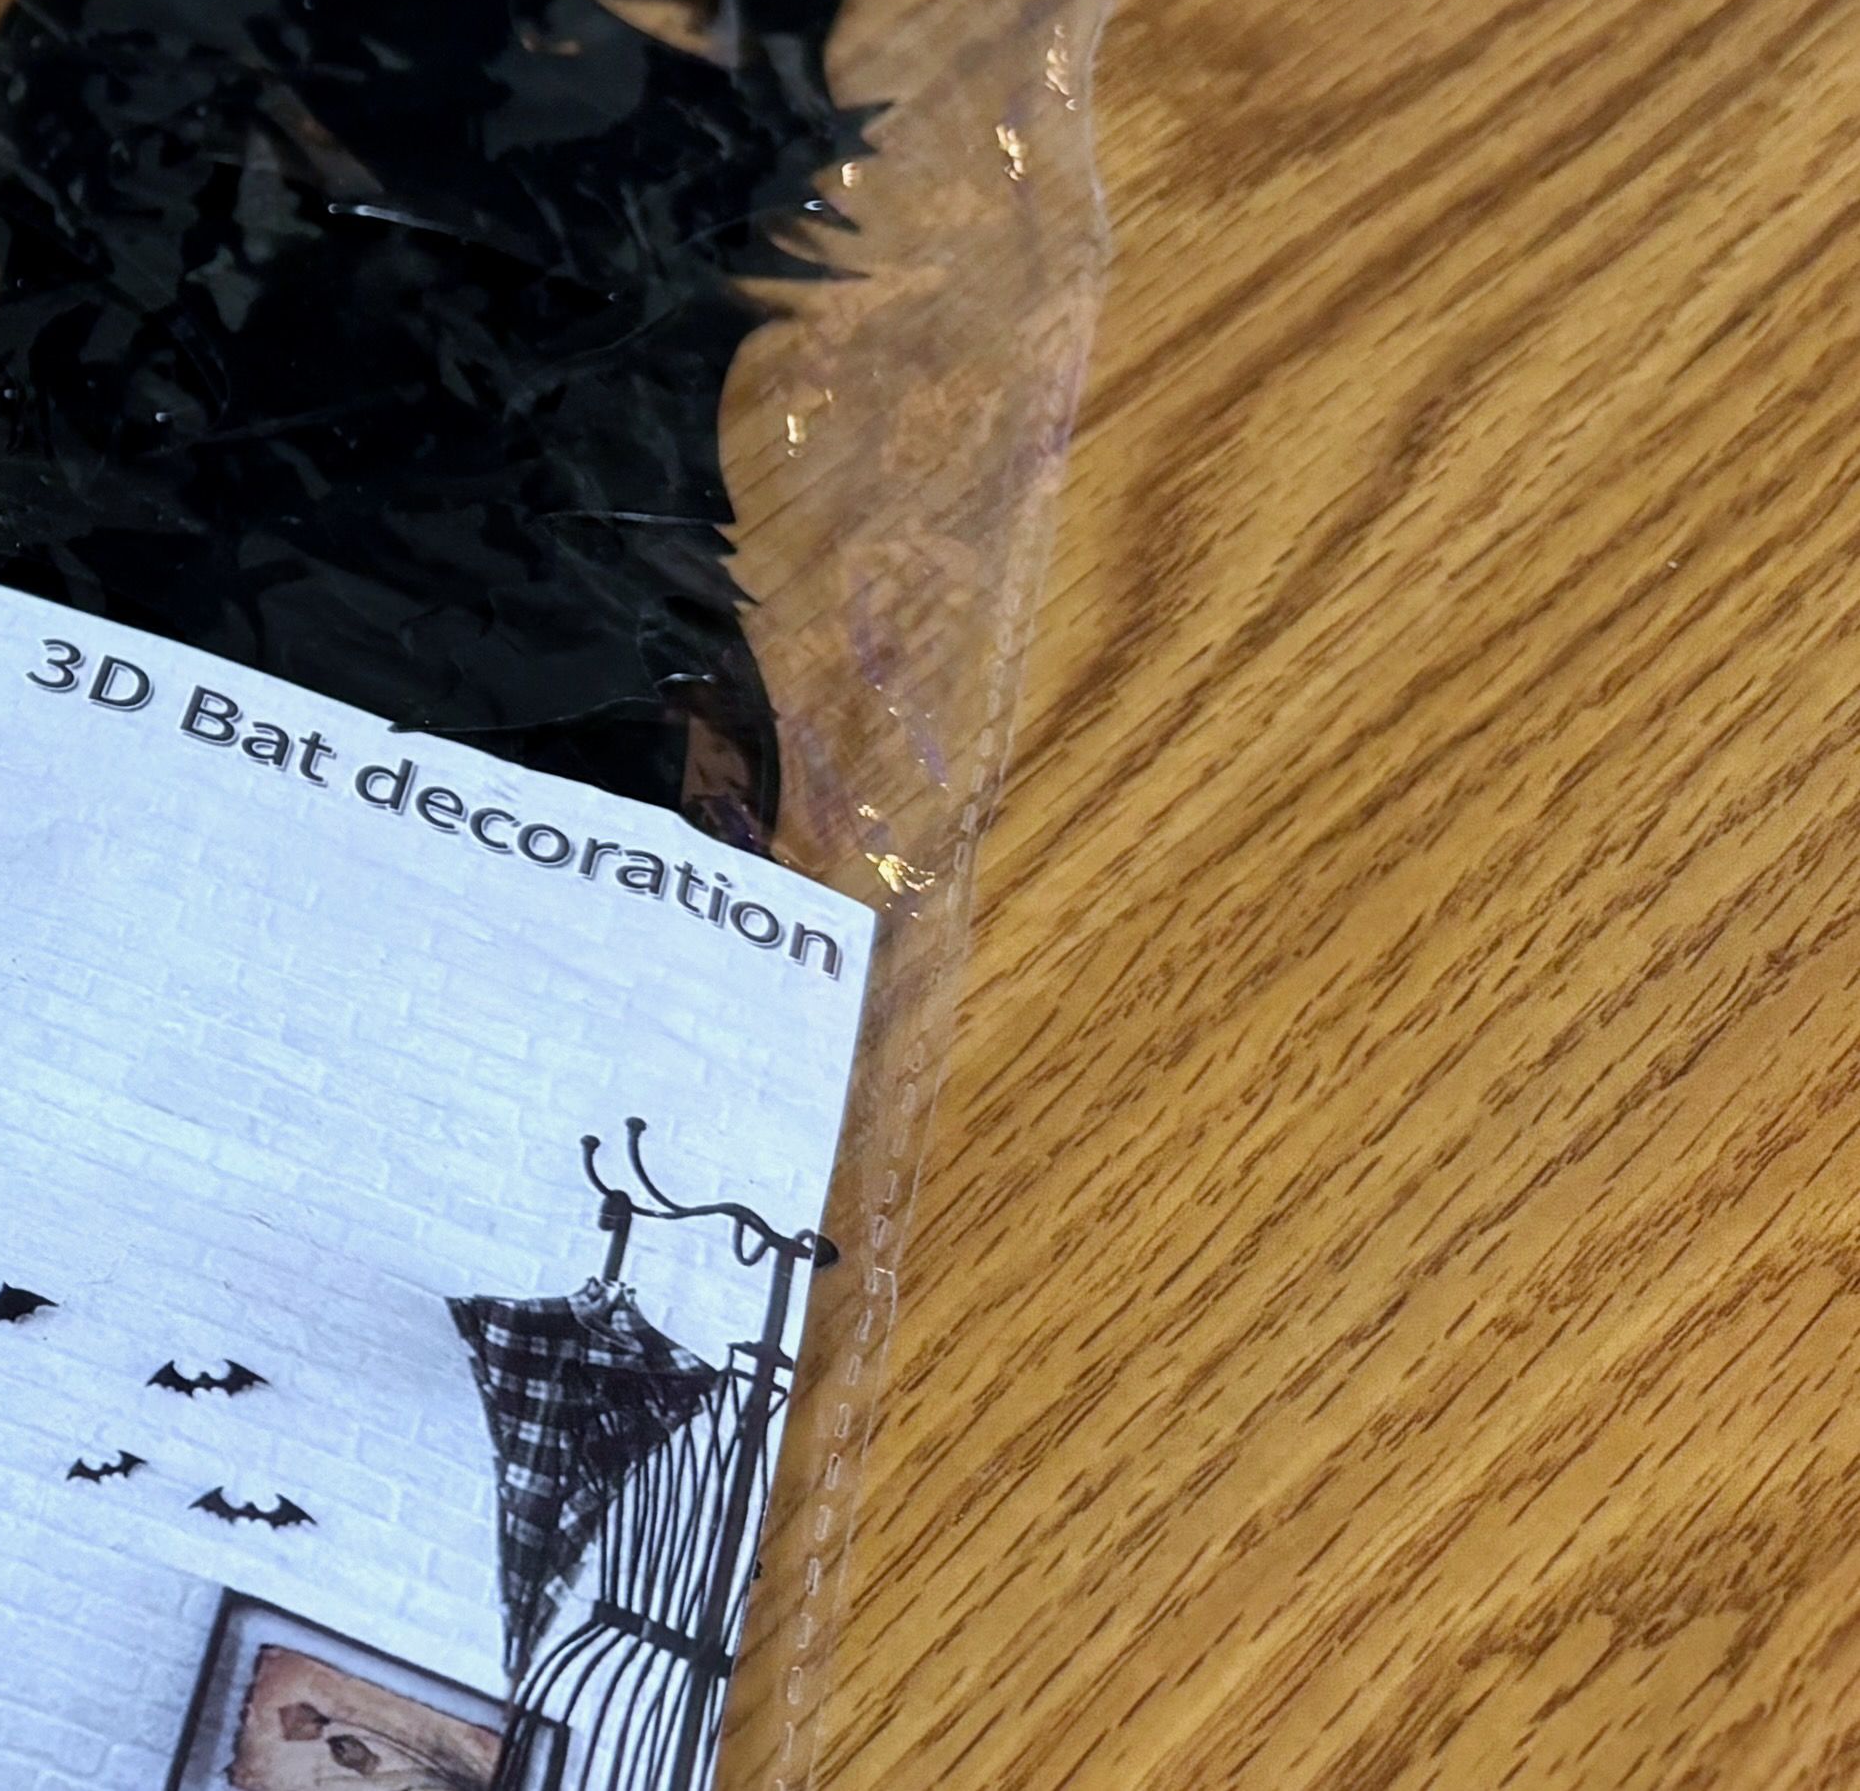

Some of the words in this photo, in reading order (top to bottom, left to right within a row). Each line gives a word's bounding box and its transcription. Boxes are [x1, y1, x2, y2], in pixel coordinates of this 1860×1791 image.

[24, 636, 154, 713] 3D
[177, 682, 336, 788] Bat
[353, 757, 845, 981] decoration
